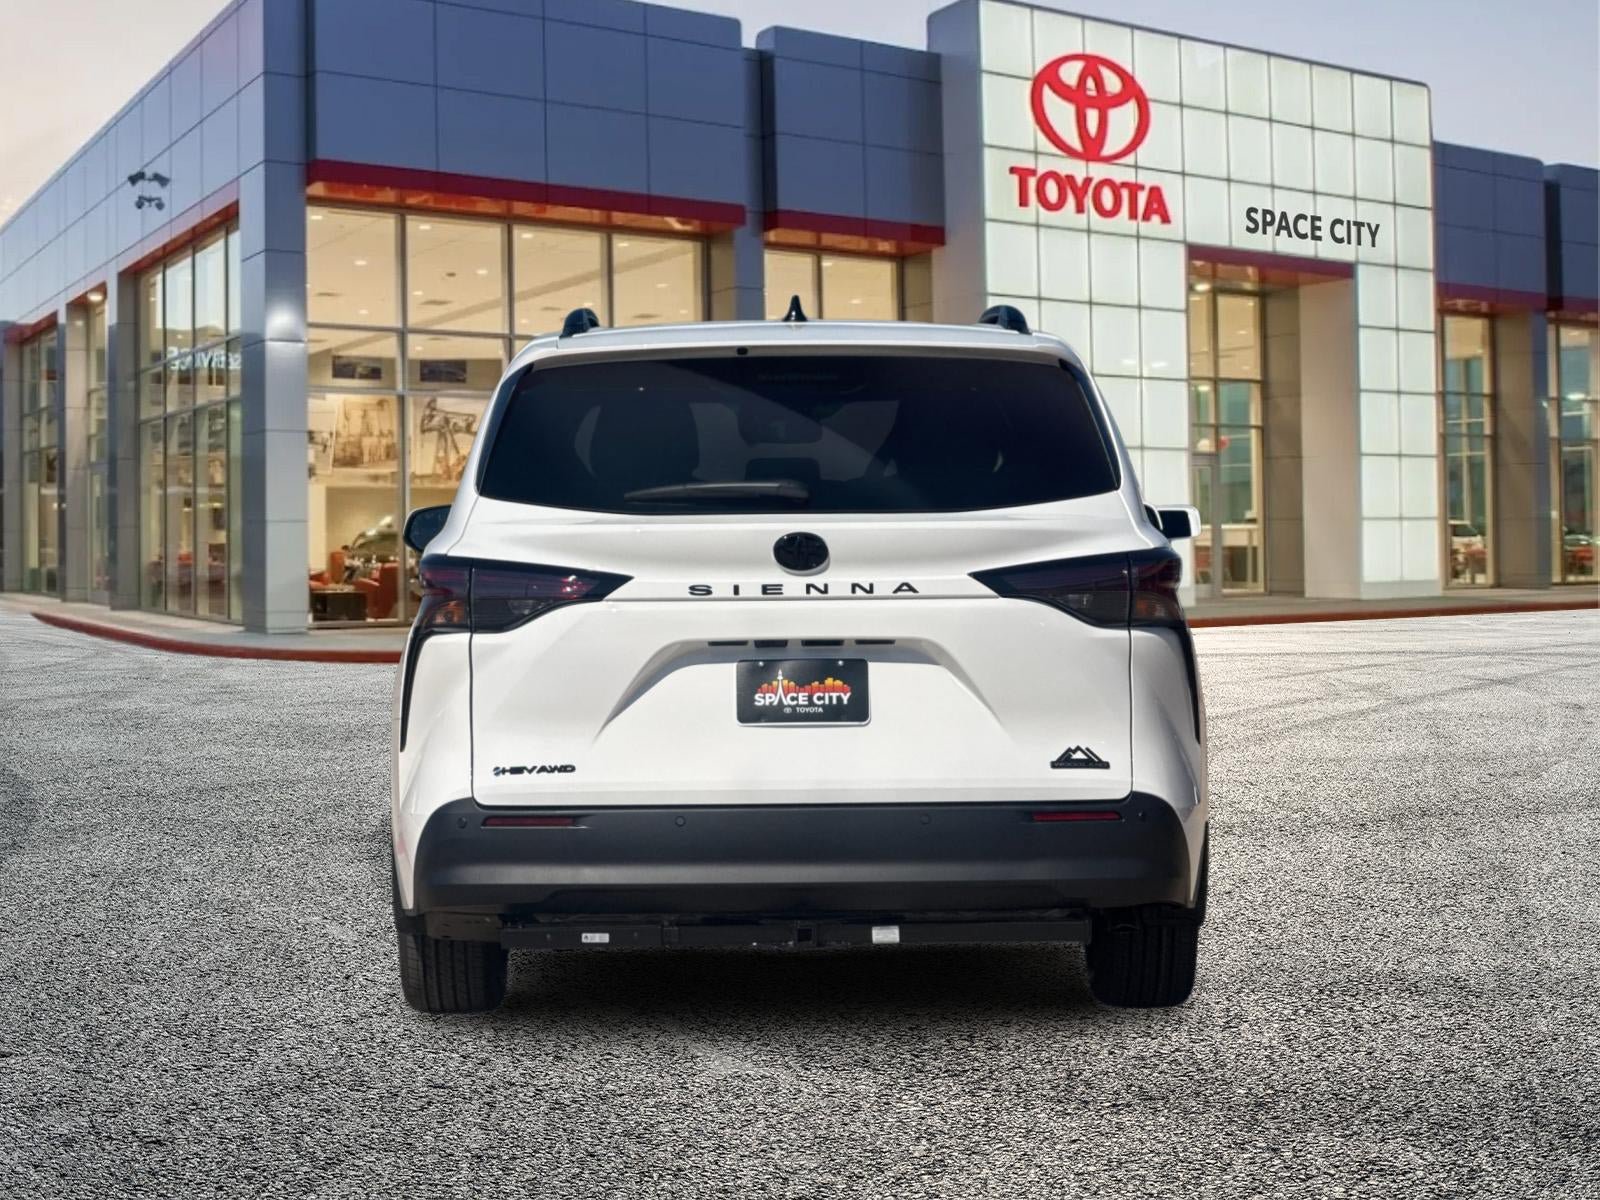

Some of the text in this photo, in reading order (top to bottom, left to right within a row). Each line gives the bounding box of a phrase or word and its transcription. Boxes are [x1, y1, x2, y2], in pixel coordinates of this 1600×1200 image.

[1009, 167, 1171, 224] TOYOTA
[1246, 207, 1380, 247] SPACE CITY
[688, 582, 919, 596] SIENNA
[754, 685, 851, 706] SPACE CITY
